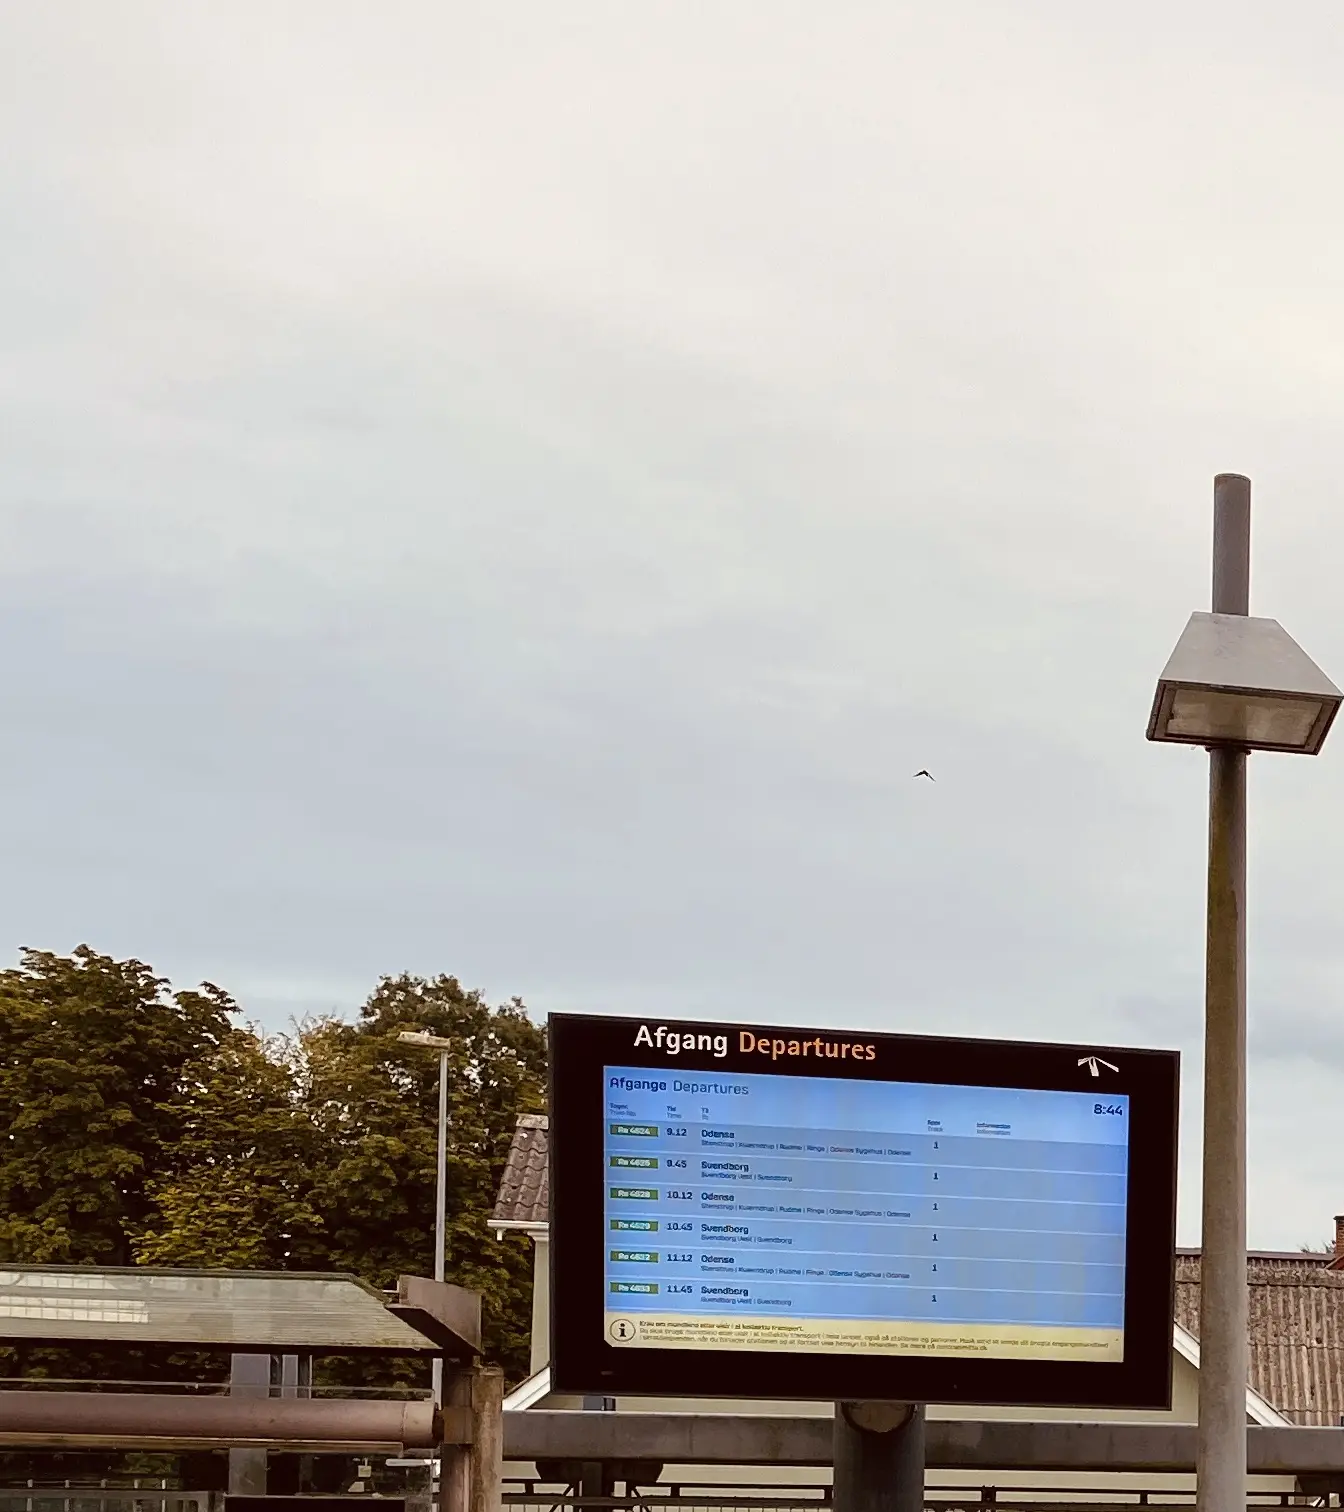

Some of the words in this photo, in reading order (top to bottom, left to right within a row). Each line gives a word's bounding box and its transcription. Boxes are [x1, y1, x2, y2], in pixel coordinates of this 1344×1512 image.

[634, 1025, 728, 1057] Afgang
[739, 1031, 876, 1060] Departures
[673, 1080, 749, 1095] Departures
[1093, 1103, 1123, 1116] 8:44
[666, 1128, 687, 1137] 9.12
[701, 1129, 735, 1139] Odense
[933, 1141, 939, 1149] 1
[666, 1159, 687, 1168] 9.45
[701, 1161, 749, 1172] Svendborg
[933, 1172, 939, 1180] 1
[667, 1191, 693, 1200] 10.12
[701, 1192, 735, 1201] Odense
[933, 1202, 938, 1210] 1
[667, 1223, 693, 1231] 10.45
[701, 1224, 749, 1234] Svendborg
[932, 1233, 938, 1241] 1
[667, 1254, 693, 1262] 11.12
[701, 1255, 735, 1263] Odense
[932, 1264, 937, 1272] 1
[667, 1285, 693, 1293] 11.45
[701, 1286, 749, 1296] Svendborg
[932, 1294, 937, 1302] 1
